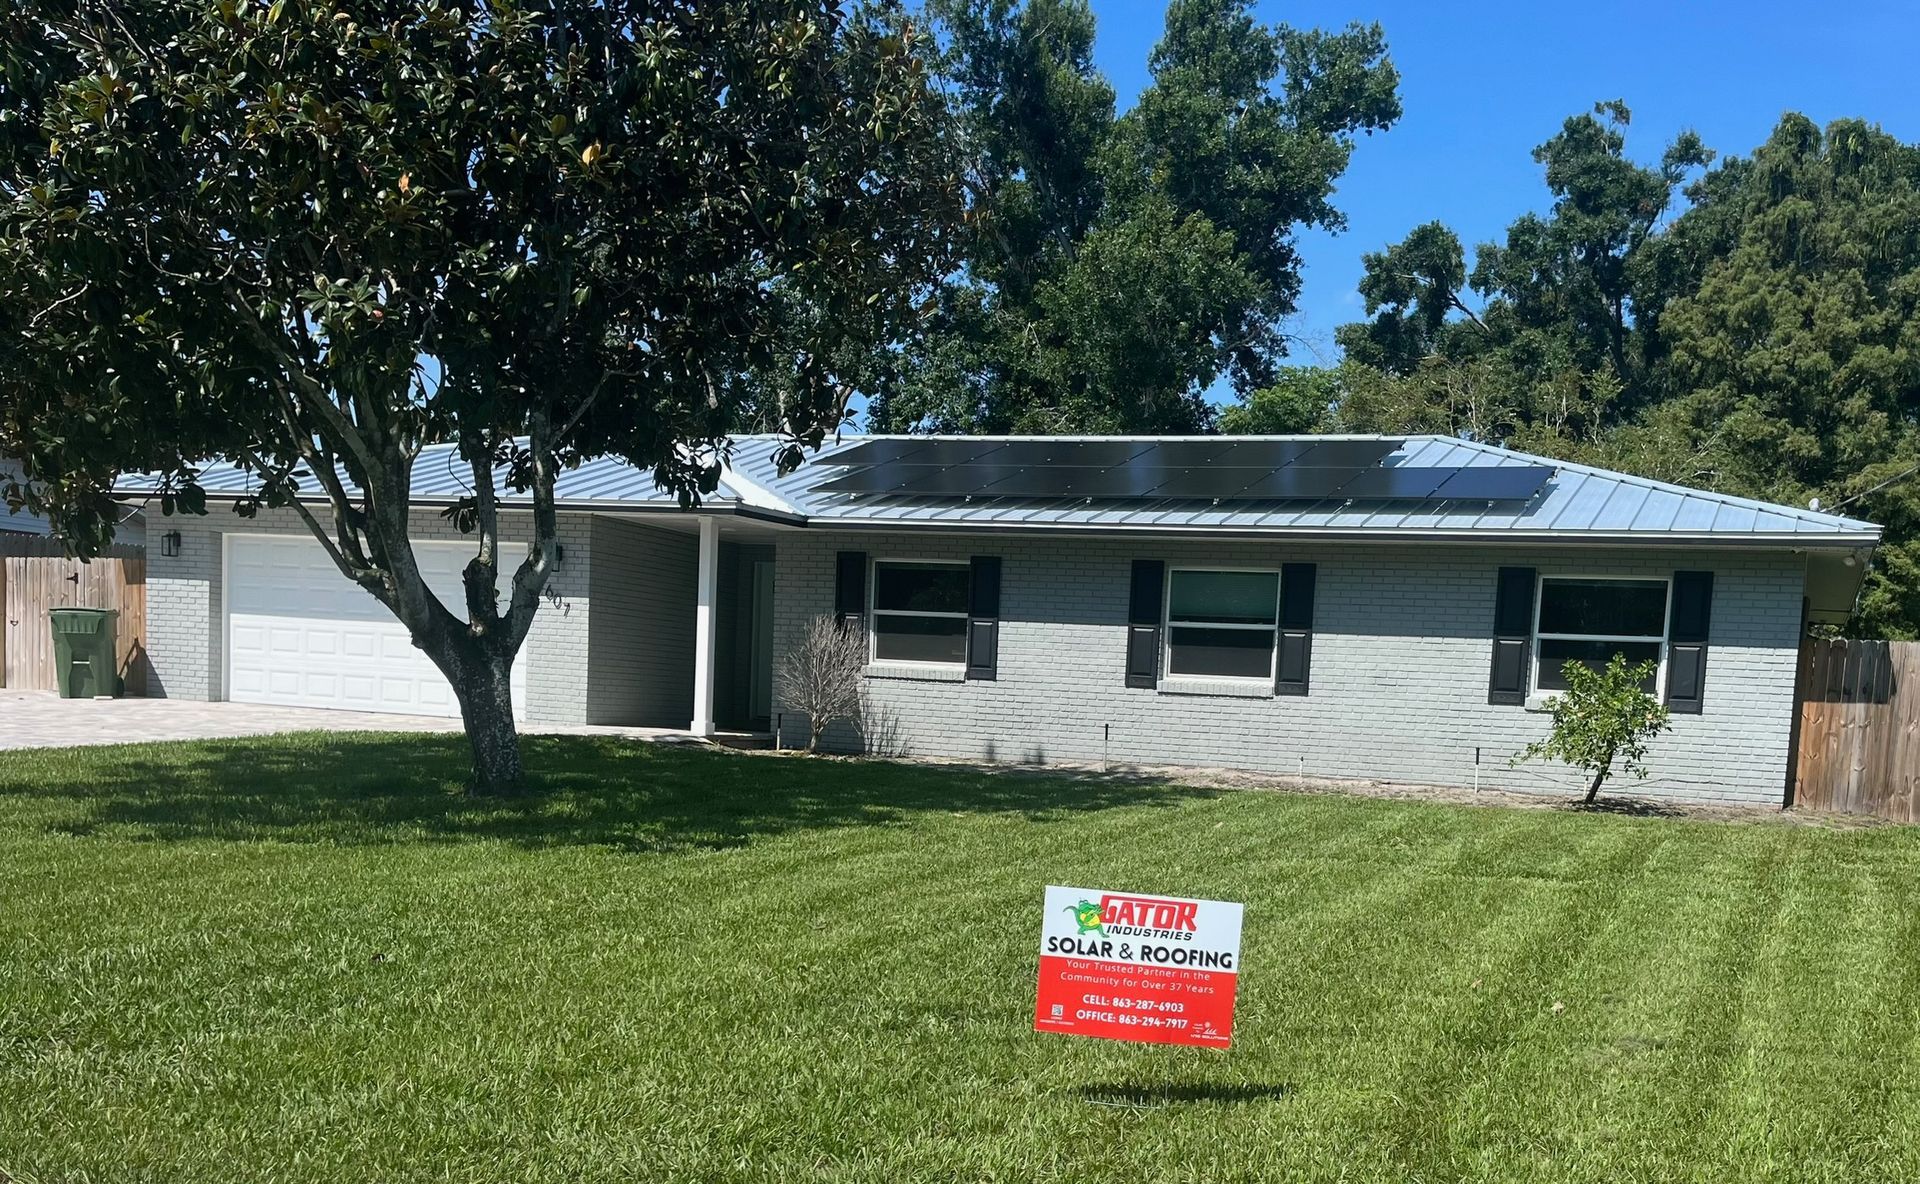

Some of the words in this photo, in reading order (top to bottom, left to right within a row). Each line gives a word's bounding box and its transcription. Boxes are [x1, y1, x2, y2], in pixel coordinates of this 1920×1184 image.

[545, 583, 571, 618] 607
[1100, 895, 1198, 932] GATOR
[1106, 925, 1193, 941] INDUSTRIES
[1048, 936, 1113, 958] SOLAR
[1119, 943, 1134, 960] &
[1140, 945, 1233, 969] ROOFING
[1066, 960, 1090, 969] Your
[1094, 962, 1133, 974] Trusted
[1137, 967, 1176, 978] Partner
[1180, 971, 1189, 979] in
[1193, 972, 1210, 981] the
[1060, 972, 1119, 987] Community
[1123, 978, 1137, 987] for
[1141, 980, 1166, 990] Over
[1170, 982, 1182, 991] 37
[1185, 984, 1214, 994] Years
[1083, 994, 1109, 1005] CELL:
[1112, 997, 1184, 1013] 863-287-6903
[1076, 1010, 1116, 1023] OFFICE:
[1118, 1014, 1188, 1029] 863-294-7917
